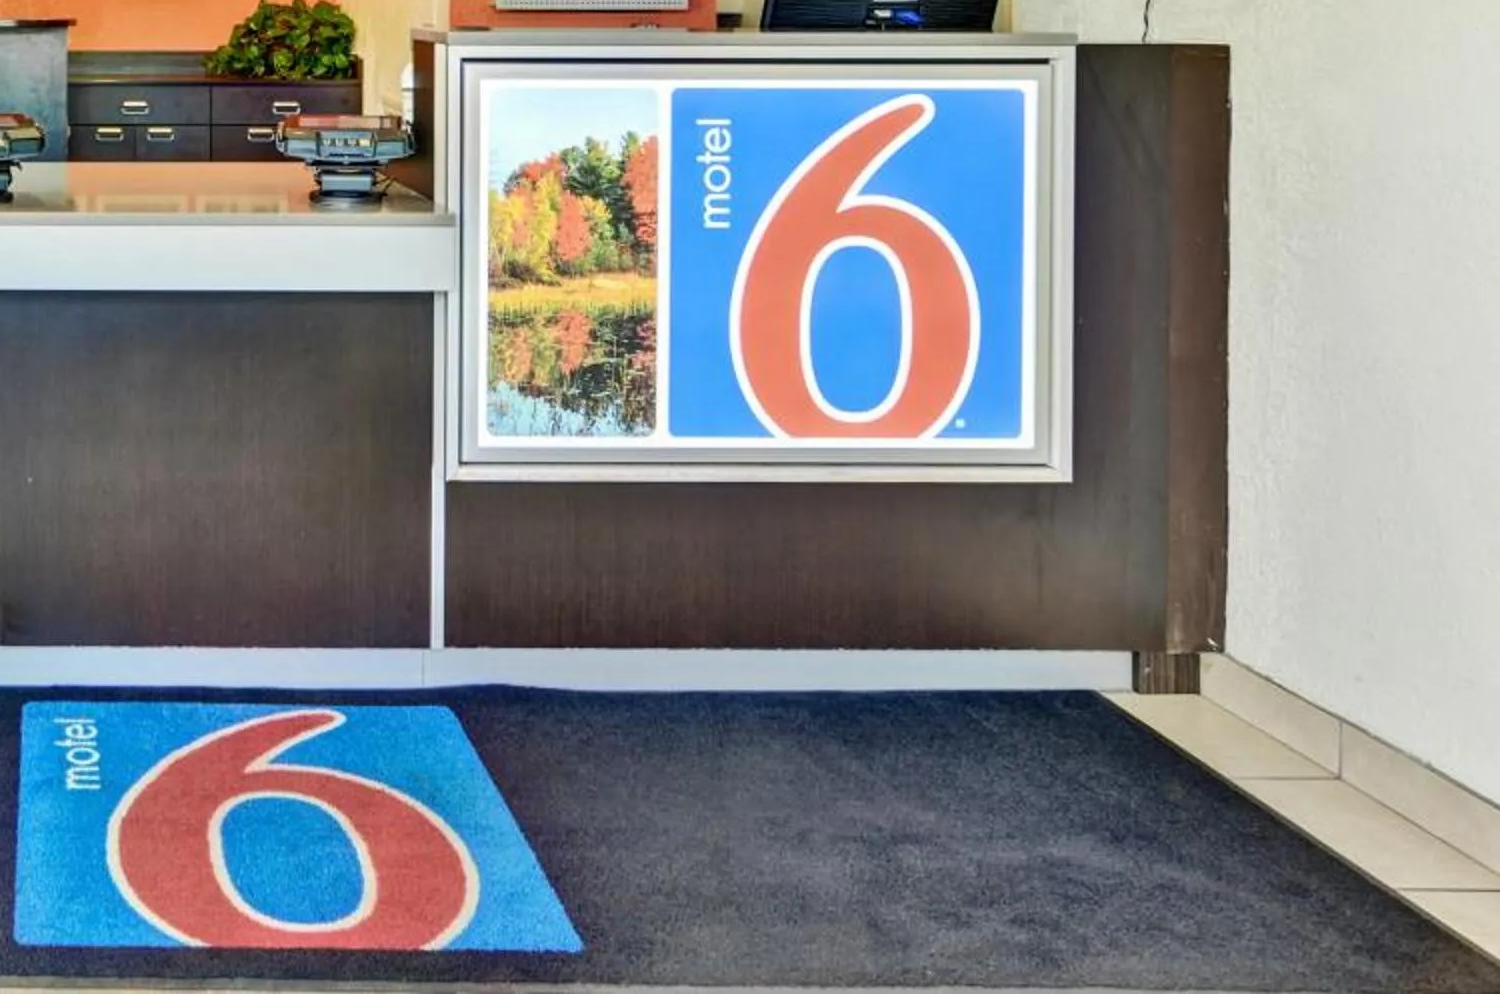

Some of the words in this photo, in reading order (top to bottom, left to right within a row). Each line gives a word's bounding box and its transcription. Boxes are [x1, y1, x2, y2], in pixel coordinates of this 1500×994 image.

[695, 117, 733, 231] motel
[728, 92, 982, 439] 6
[53, 715, 101, 791] motel
[105, 708, 481, 951] 6
